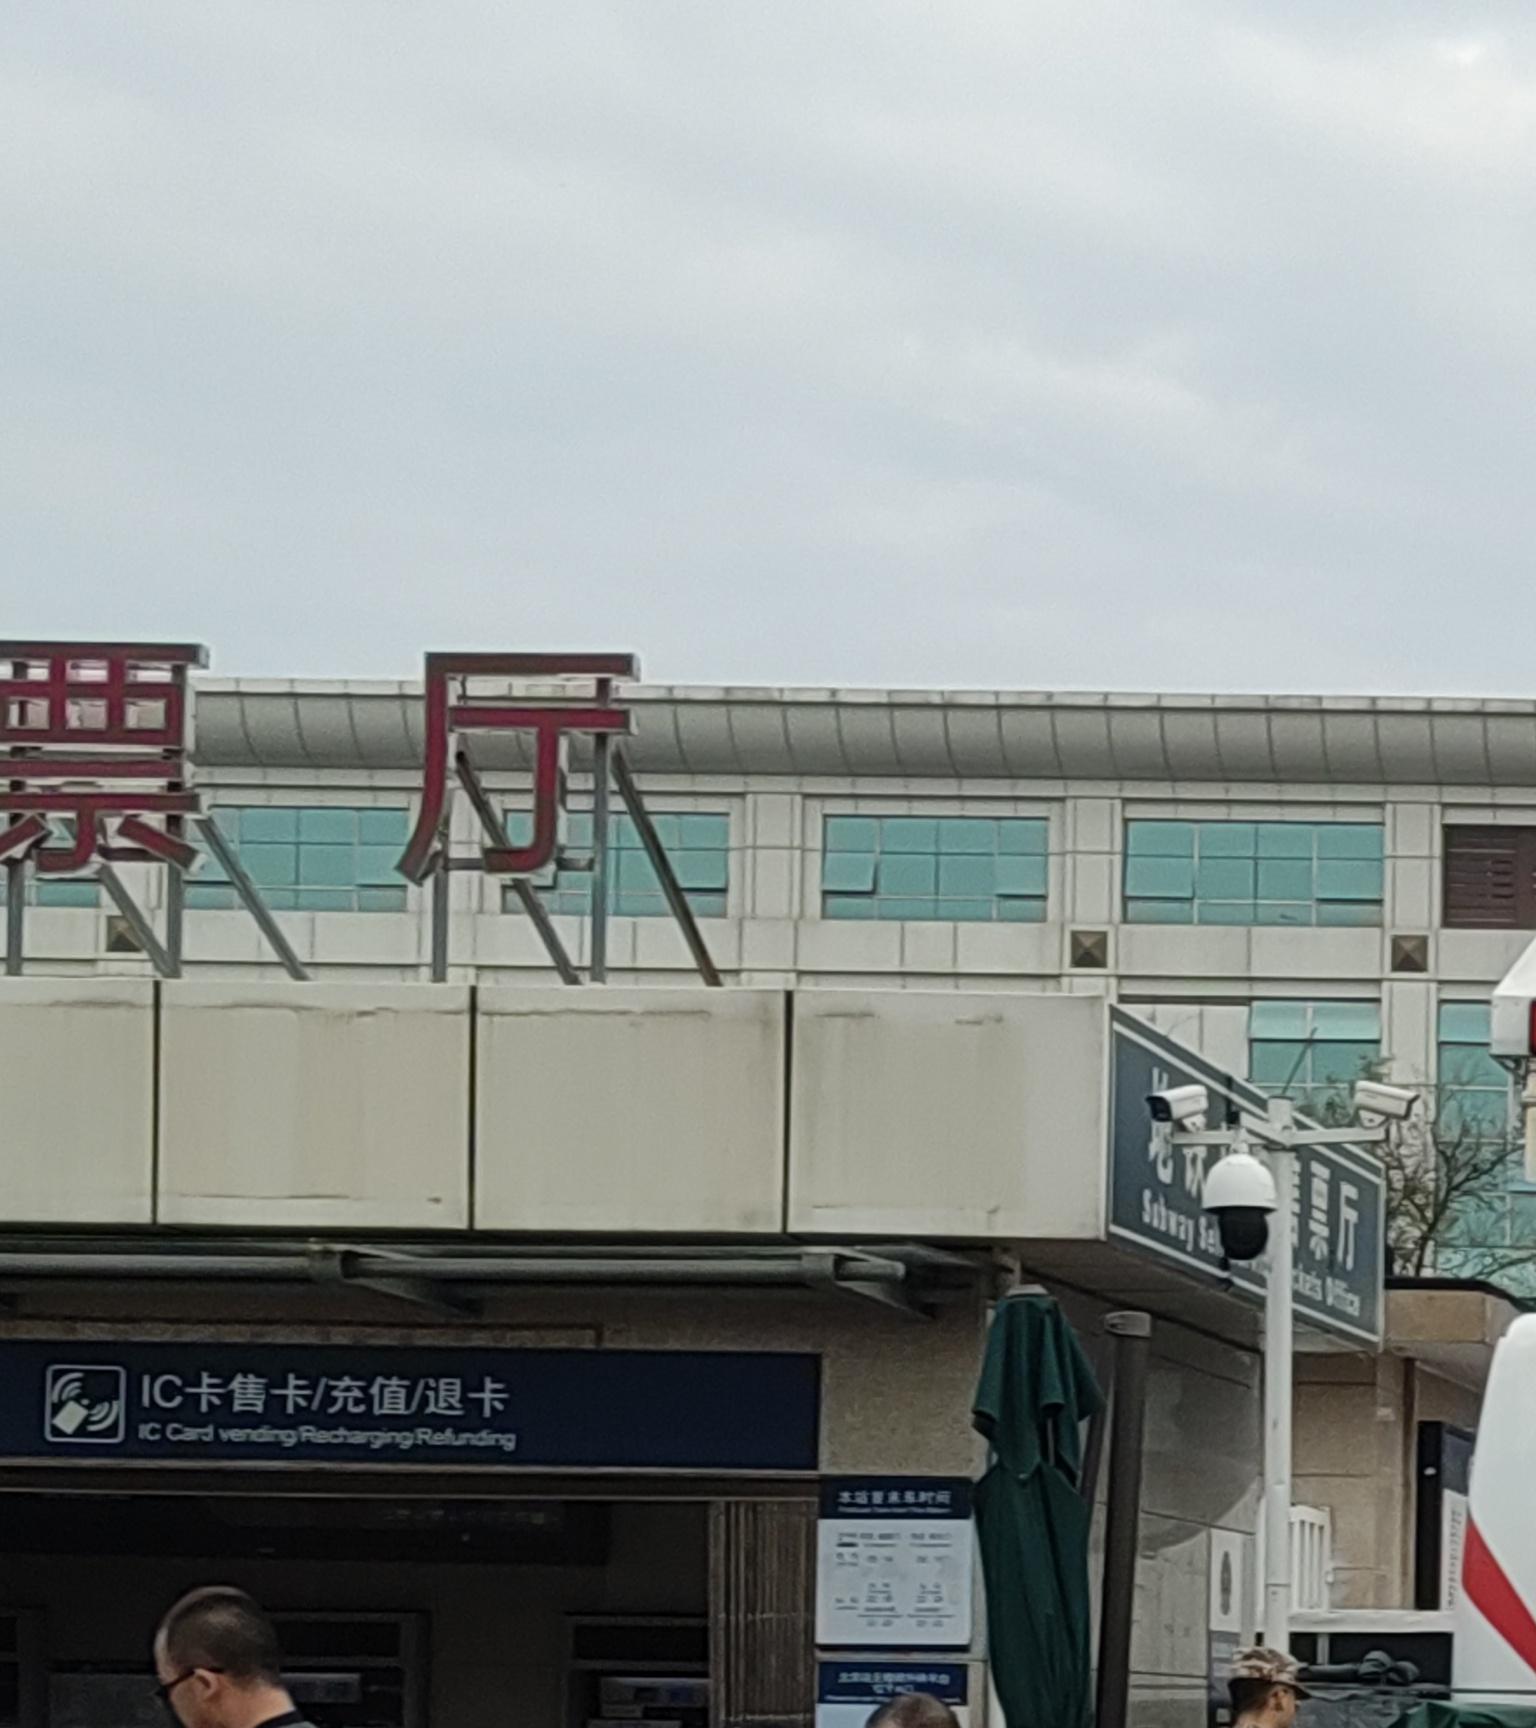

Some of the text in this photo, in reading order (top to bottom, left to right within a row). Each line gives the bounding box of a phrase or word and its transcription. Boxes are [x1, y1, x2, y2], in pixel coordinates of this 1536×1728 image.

[0, 641, 641, 884] 票厅
[1142, 1189, 1194, 1252] Subway
[141, 1371, 511, 1418] IC卡售卡/充值/退卡
[138, 1423, 162, 1441] IC
[167, 1423, 214, 1442] Card
